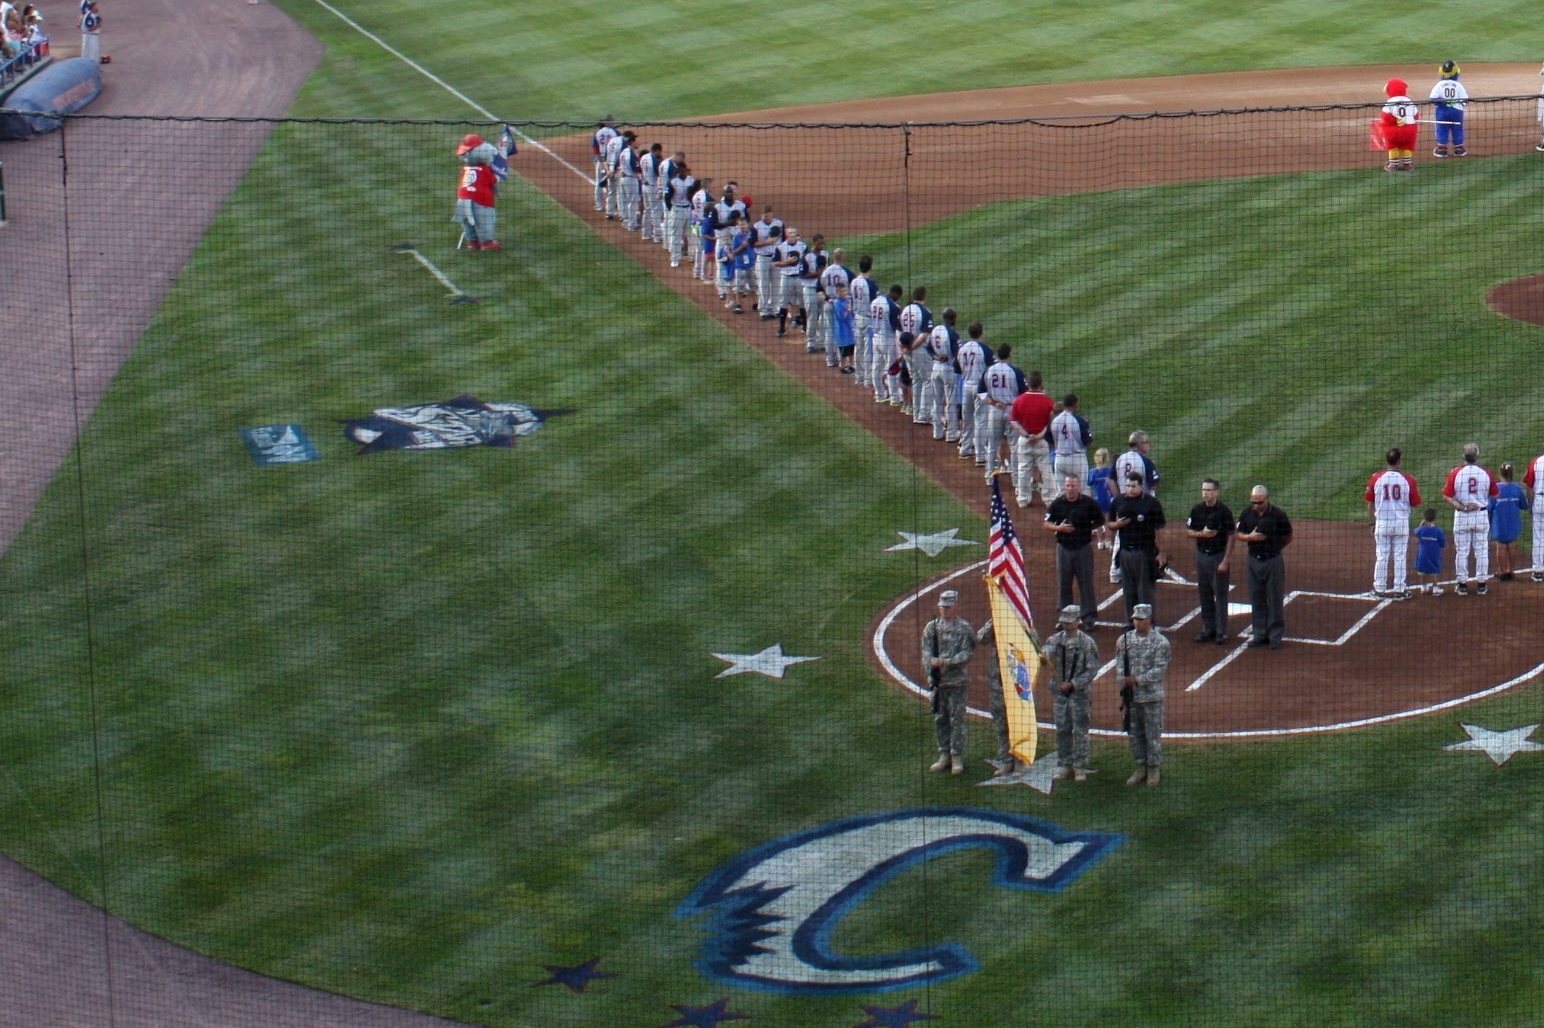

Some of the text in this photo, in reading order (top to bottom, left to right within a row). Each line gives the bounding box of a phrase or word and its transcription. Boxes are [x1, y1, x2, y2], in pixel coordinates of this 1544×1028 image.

[1444, 87, 1456, 99] 00
[1399, 106, 1406, 117] 0
[827, 274, 840, 286] 10
[992, 373, 1007, 388] 21
[1383, 484, 1402, 501] 10
[1468, 477, 1477, 494] 2
[674, 806, 1130, 996] C
